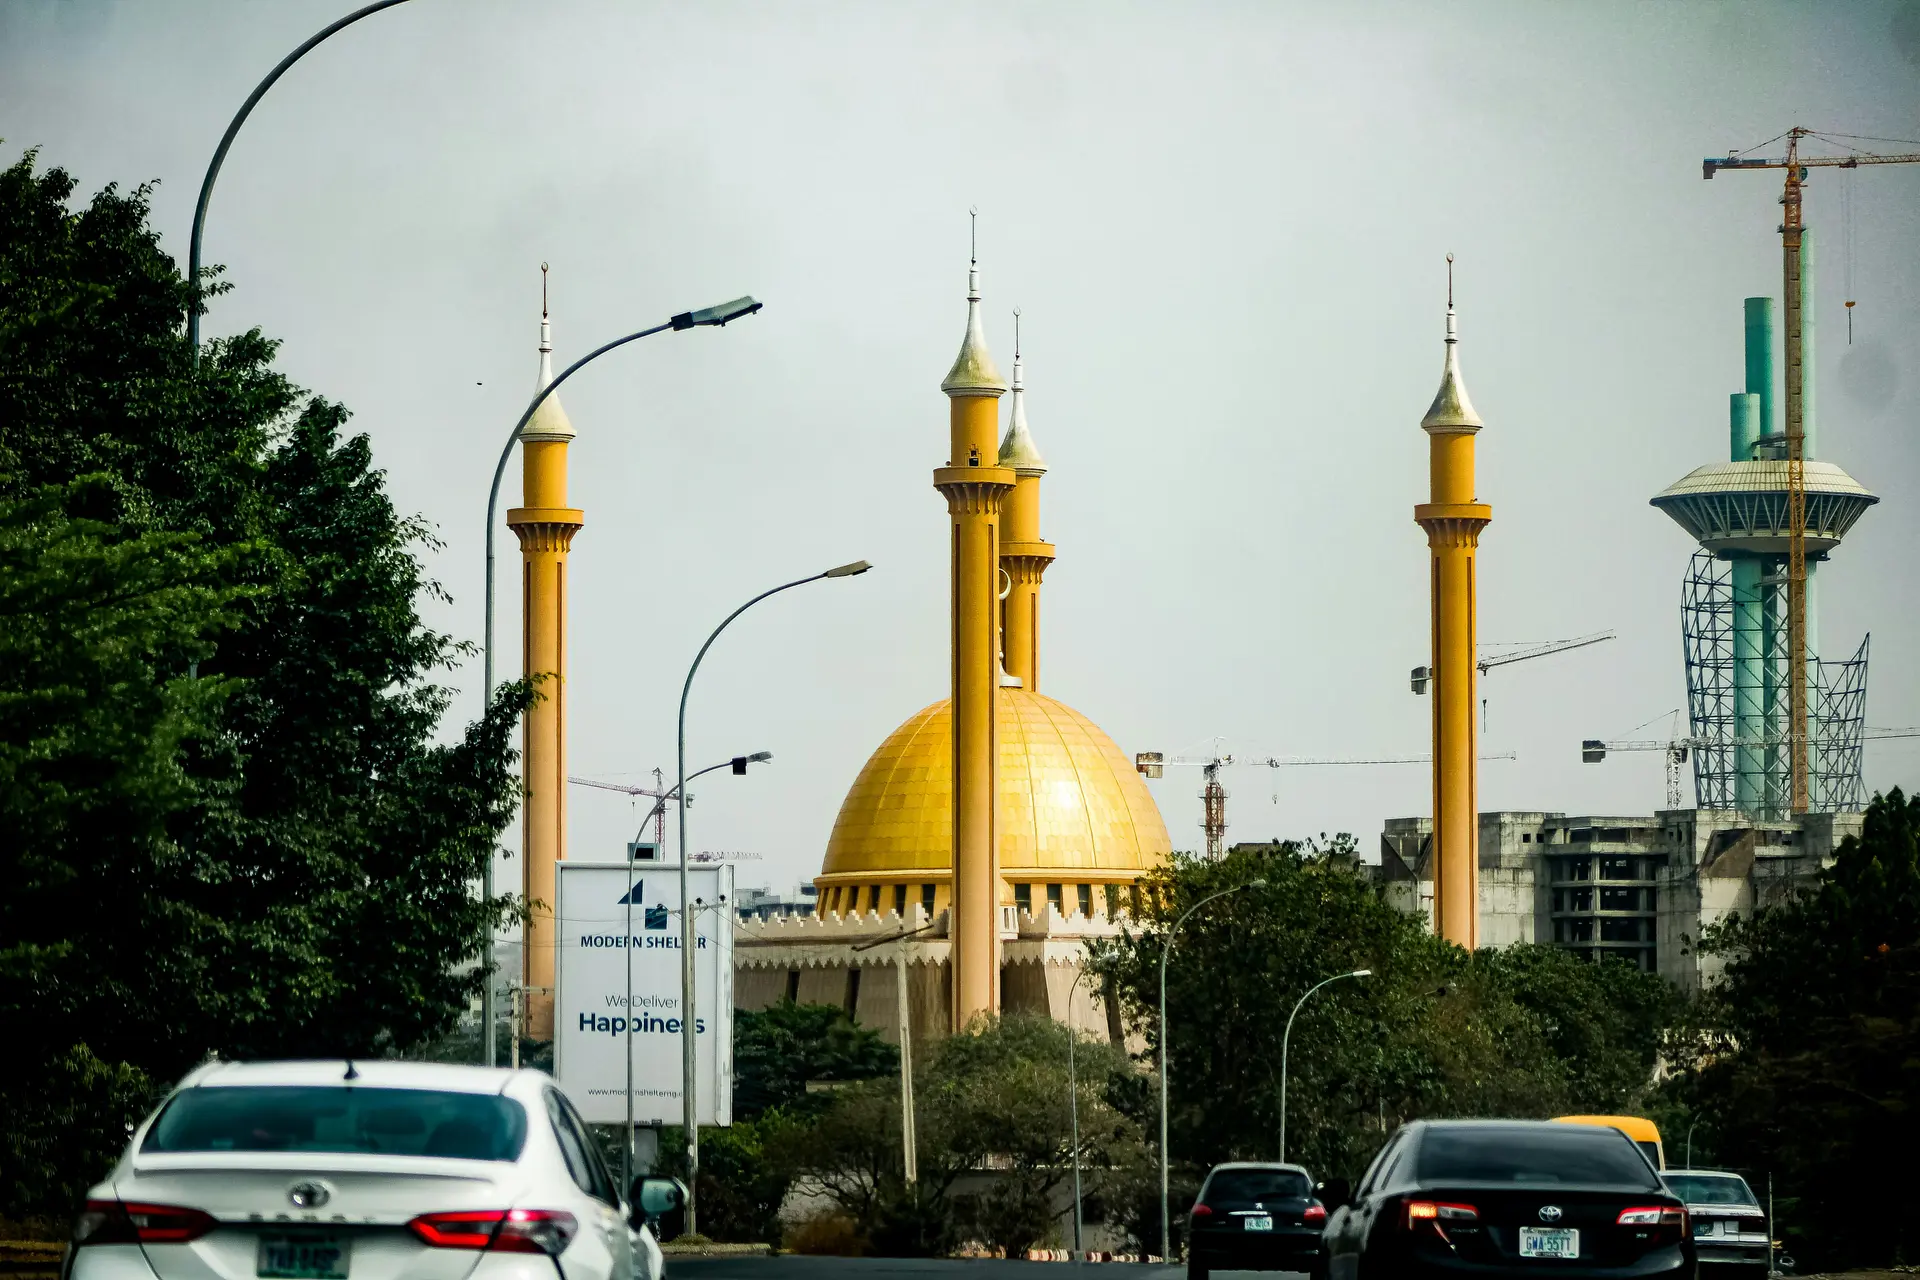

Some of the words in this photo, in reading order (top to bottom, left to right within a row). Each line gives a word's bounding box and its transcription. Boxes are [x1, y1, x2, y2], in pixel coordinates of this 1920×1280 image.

[646, 936, 707, 949] SHELR
[605, 995, 628, 1007] We
[632, 995, 678, 1008] Deliver
